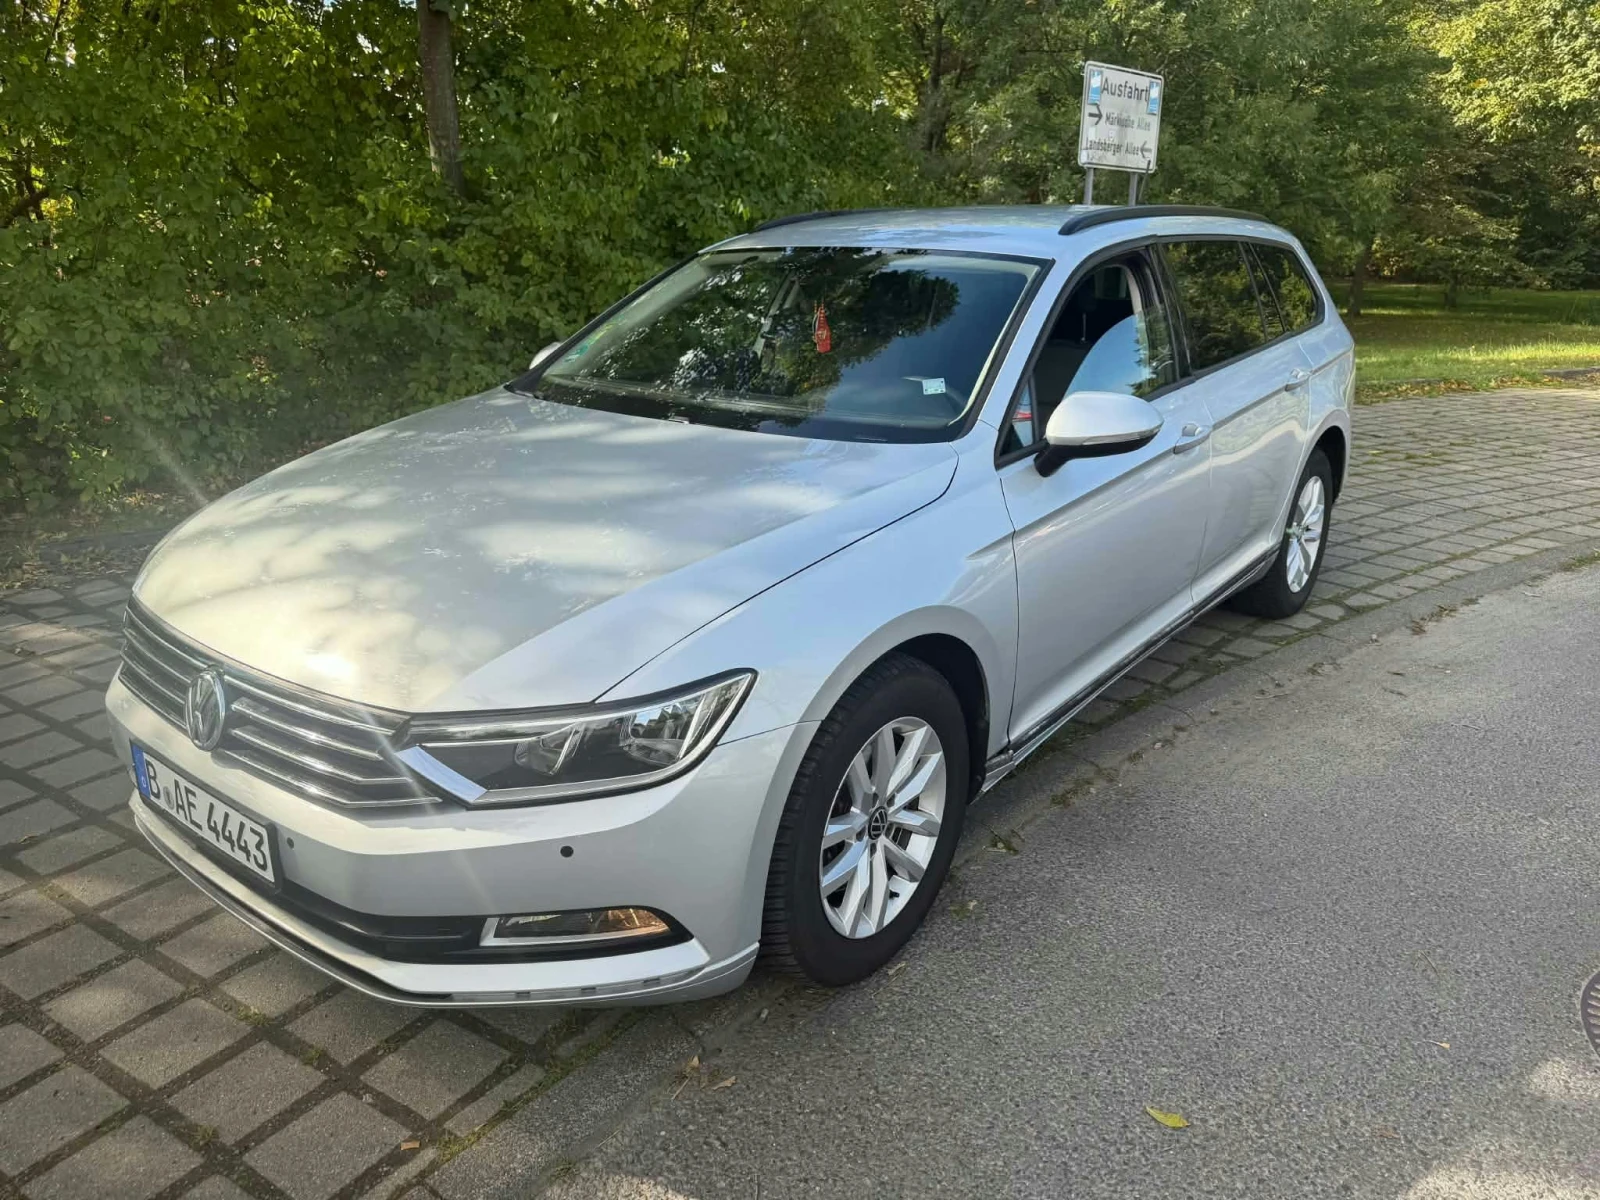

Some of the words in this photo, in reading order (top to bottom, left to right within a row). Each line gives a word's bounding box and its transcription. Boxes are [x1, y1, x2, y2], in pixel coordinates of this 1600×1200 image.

[1101, 77, 1149, 104] Ausfahrt
[1086, 137, 1123, 156] Landsberger
[1125, 142, 1139, 155] Allee
[145, 759, 160, 799] B
[174, 778, 203, 831] AE
[207, 802, 268, 871] 4443
